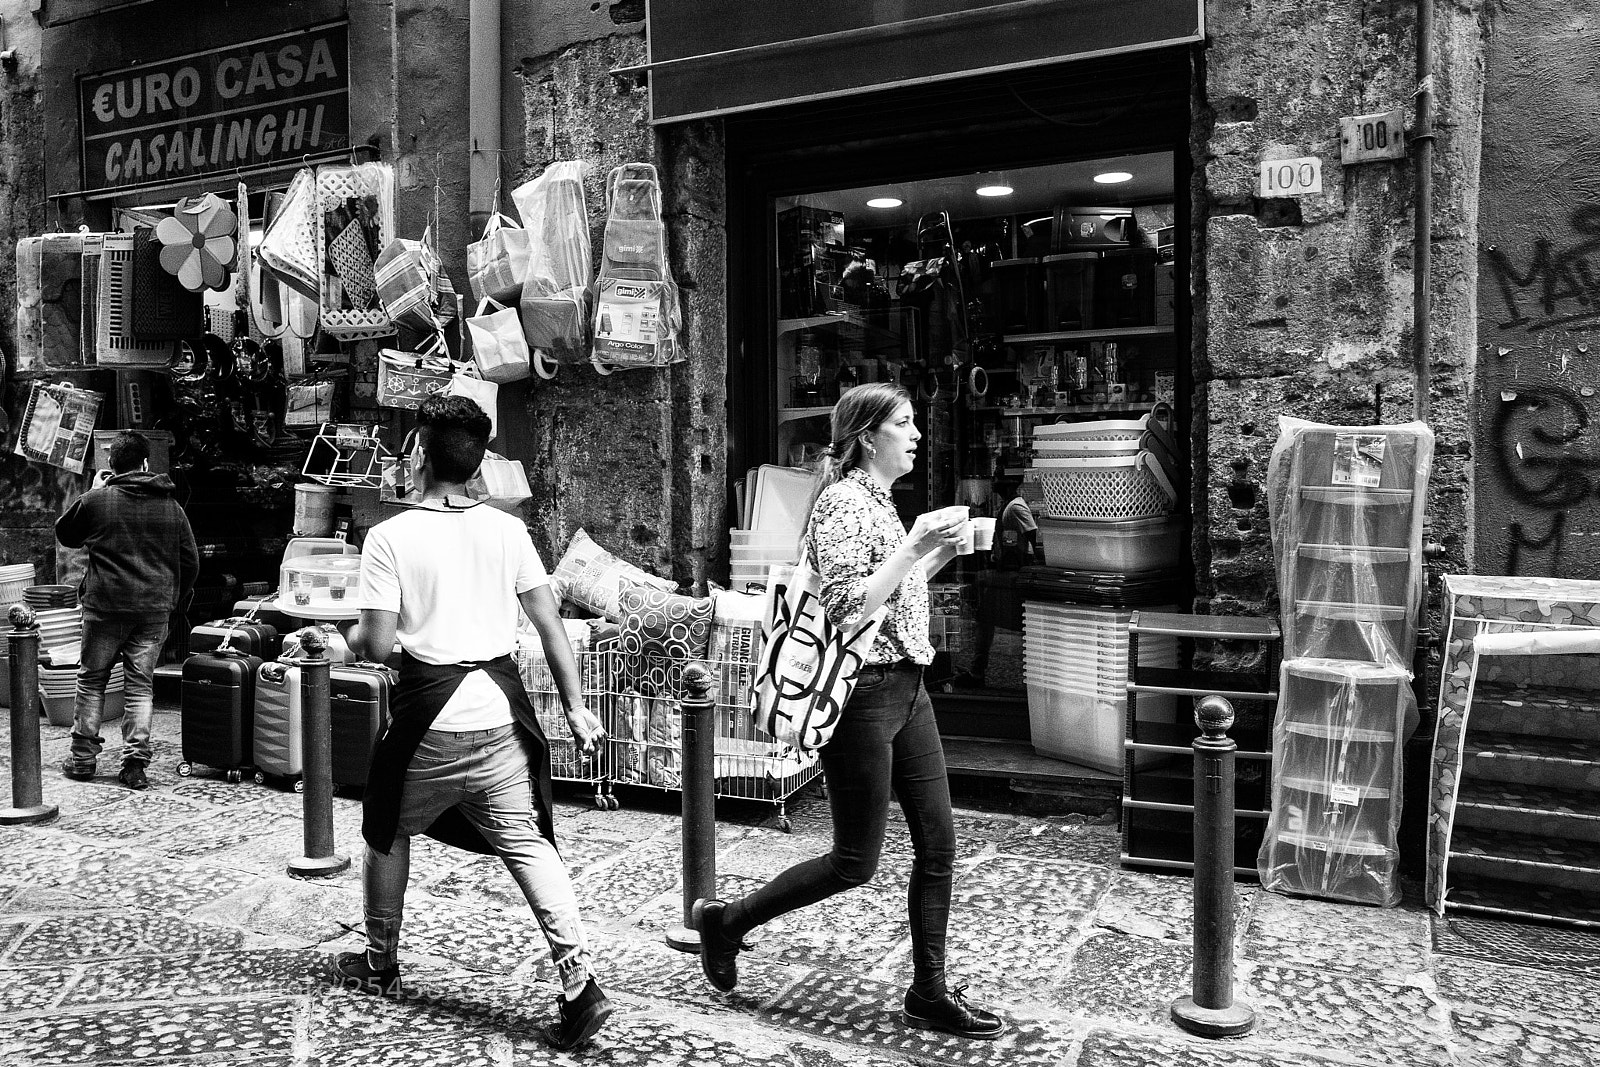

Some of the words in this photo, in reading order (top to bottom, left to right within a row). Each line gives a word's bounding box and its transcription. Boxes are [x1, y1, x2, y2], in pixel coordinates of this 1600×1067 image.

[215, 38, 338, 99] CASA
[104, 104, 325, 182] CASALINGHI
[1266, 163, 1315, 190] 100
[617, 287, 635, 297] gimi
[607, 340, 625, 348] Argo
[625, 342, 645, 350] Color
[739, 627, 752, 687] GUANCIALE
